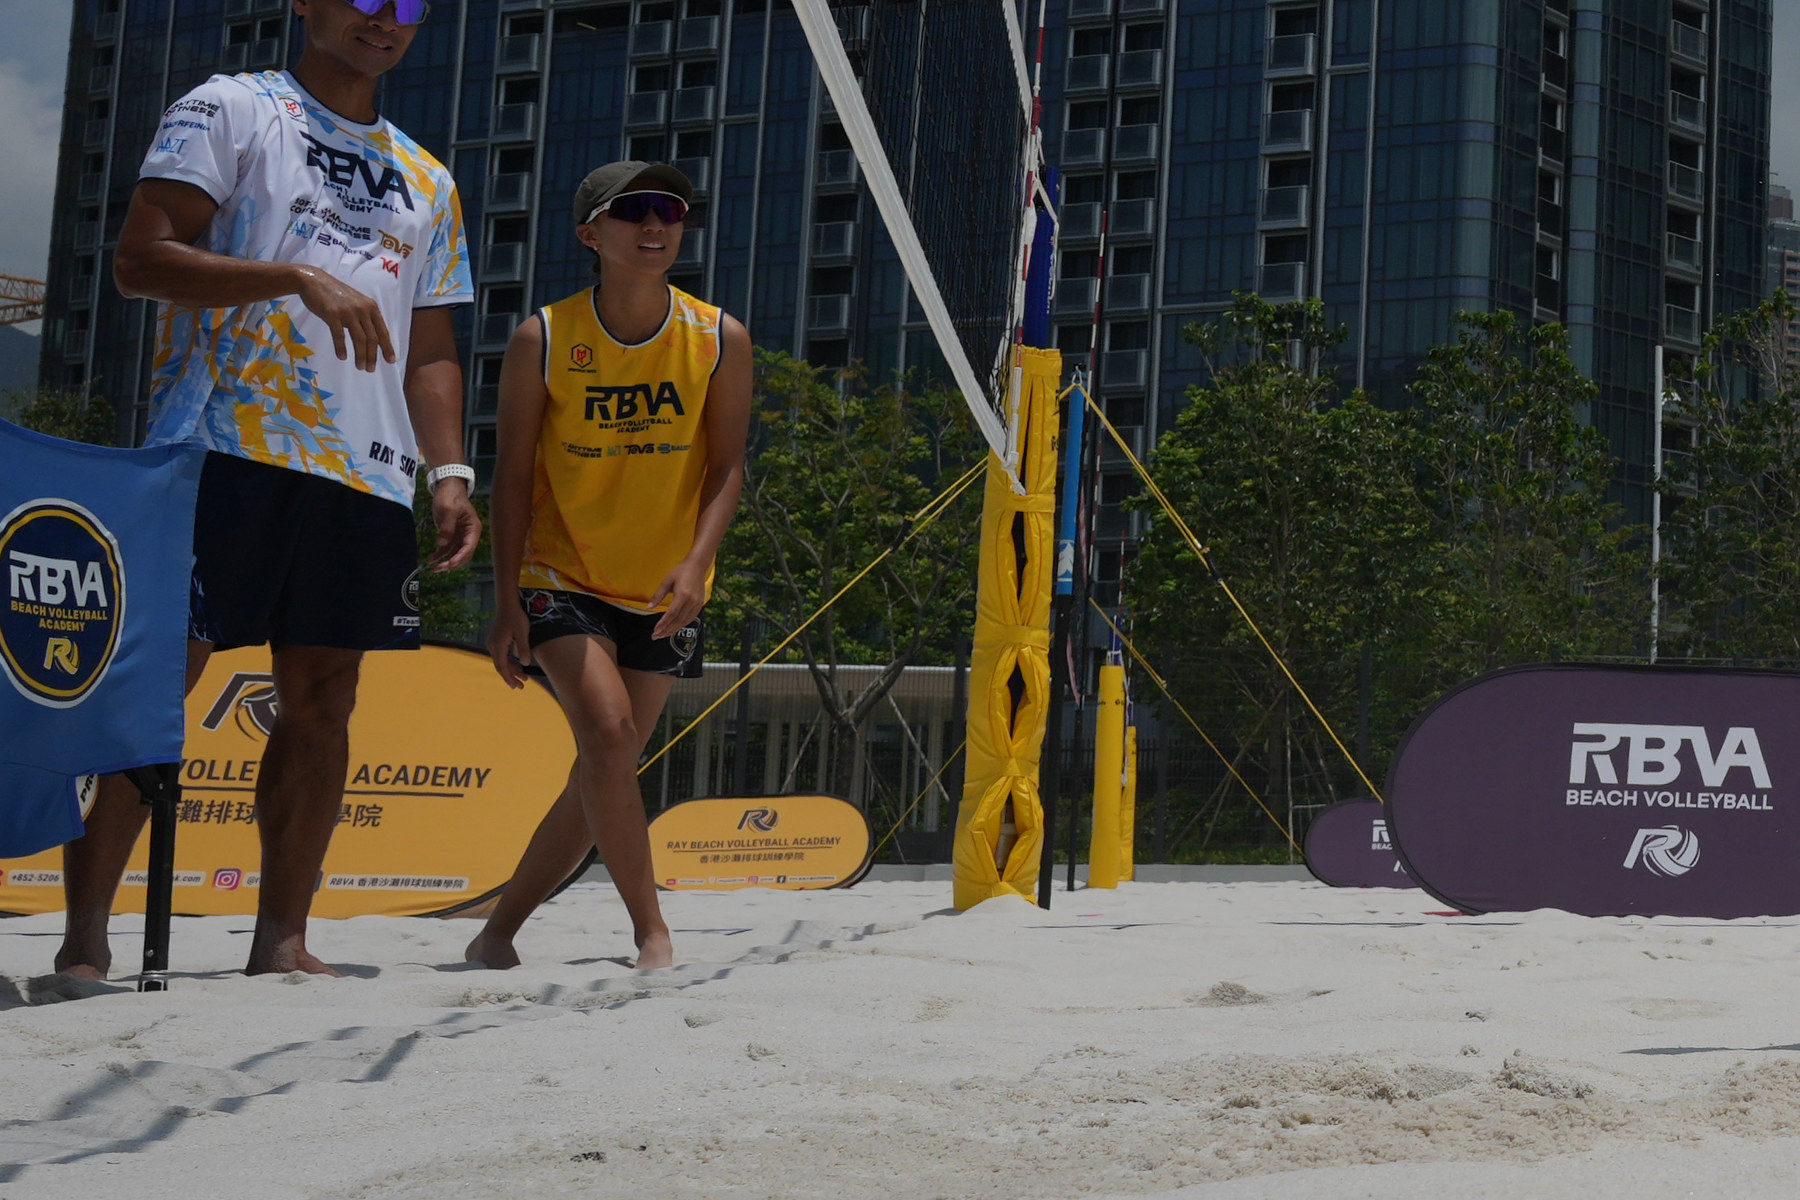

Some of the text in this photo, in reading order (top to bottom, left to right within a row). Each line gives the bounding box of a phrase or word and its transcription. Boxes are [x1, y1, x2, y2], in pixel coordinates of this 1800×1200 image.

[585, 381, 685, 421] RBVA
[9, 550, 108, 607] RBVA
[10, 600, 108, 621] BEACH VOLLEYBALL
[39, 618, 86, 632] ACADEMY
[1568, 722, 1773, 789] RBVA
[352, 763, 492, 789] ACADEMY
[1566, 789, 1774, 810] BEACH VOLLEYBALL
[667, 836, 841, 850] RAY BEACH VOLLEYBALL ACADEMY
[1371, 842, 1393, 850] BEAC
[329, 877, 355, 886] RBVA
